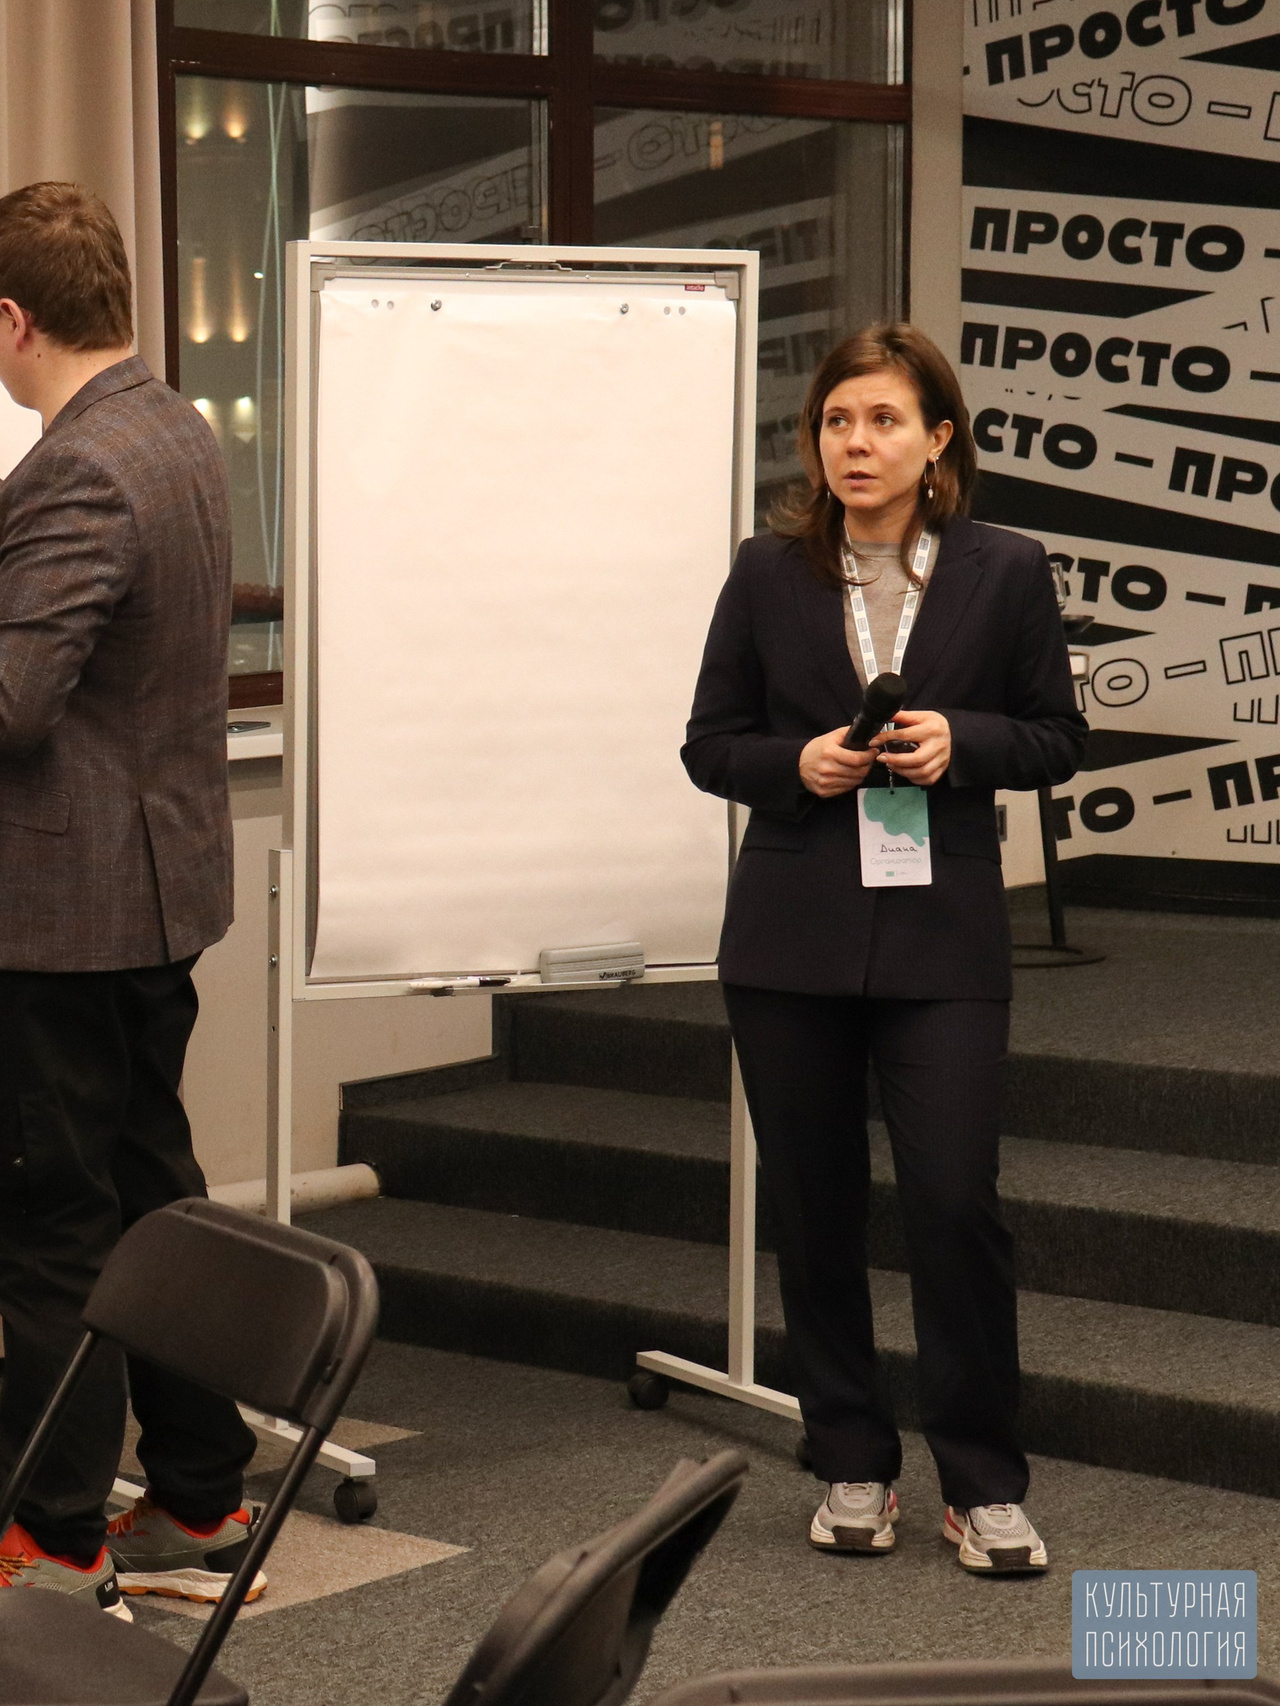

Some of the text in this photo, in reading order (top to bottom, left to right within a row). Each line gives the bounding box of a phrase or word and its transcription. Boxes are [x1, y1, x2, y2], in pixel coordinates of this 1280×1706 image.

[985, 0, 1266, 86] ПРОСТО
[970, 206, 1245, 272] ПРОСТО
[961, 321, 1231, 393] ПРОСТО
[972, 408, 1098, 470] СТО
[1168, 446, 1280, 514] ПР
[880, 844, 918, 853] Диана
